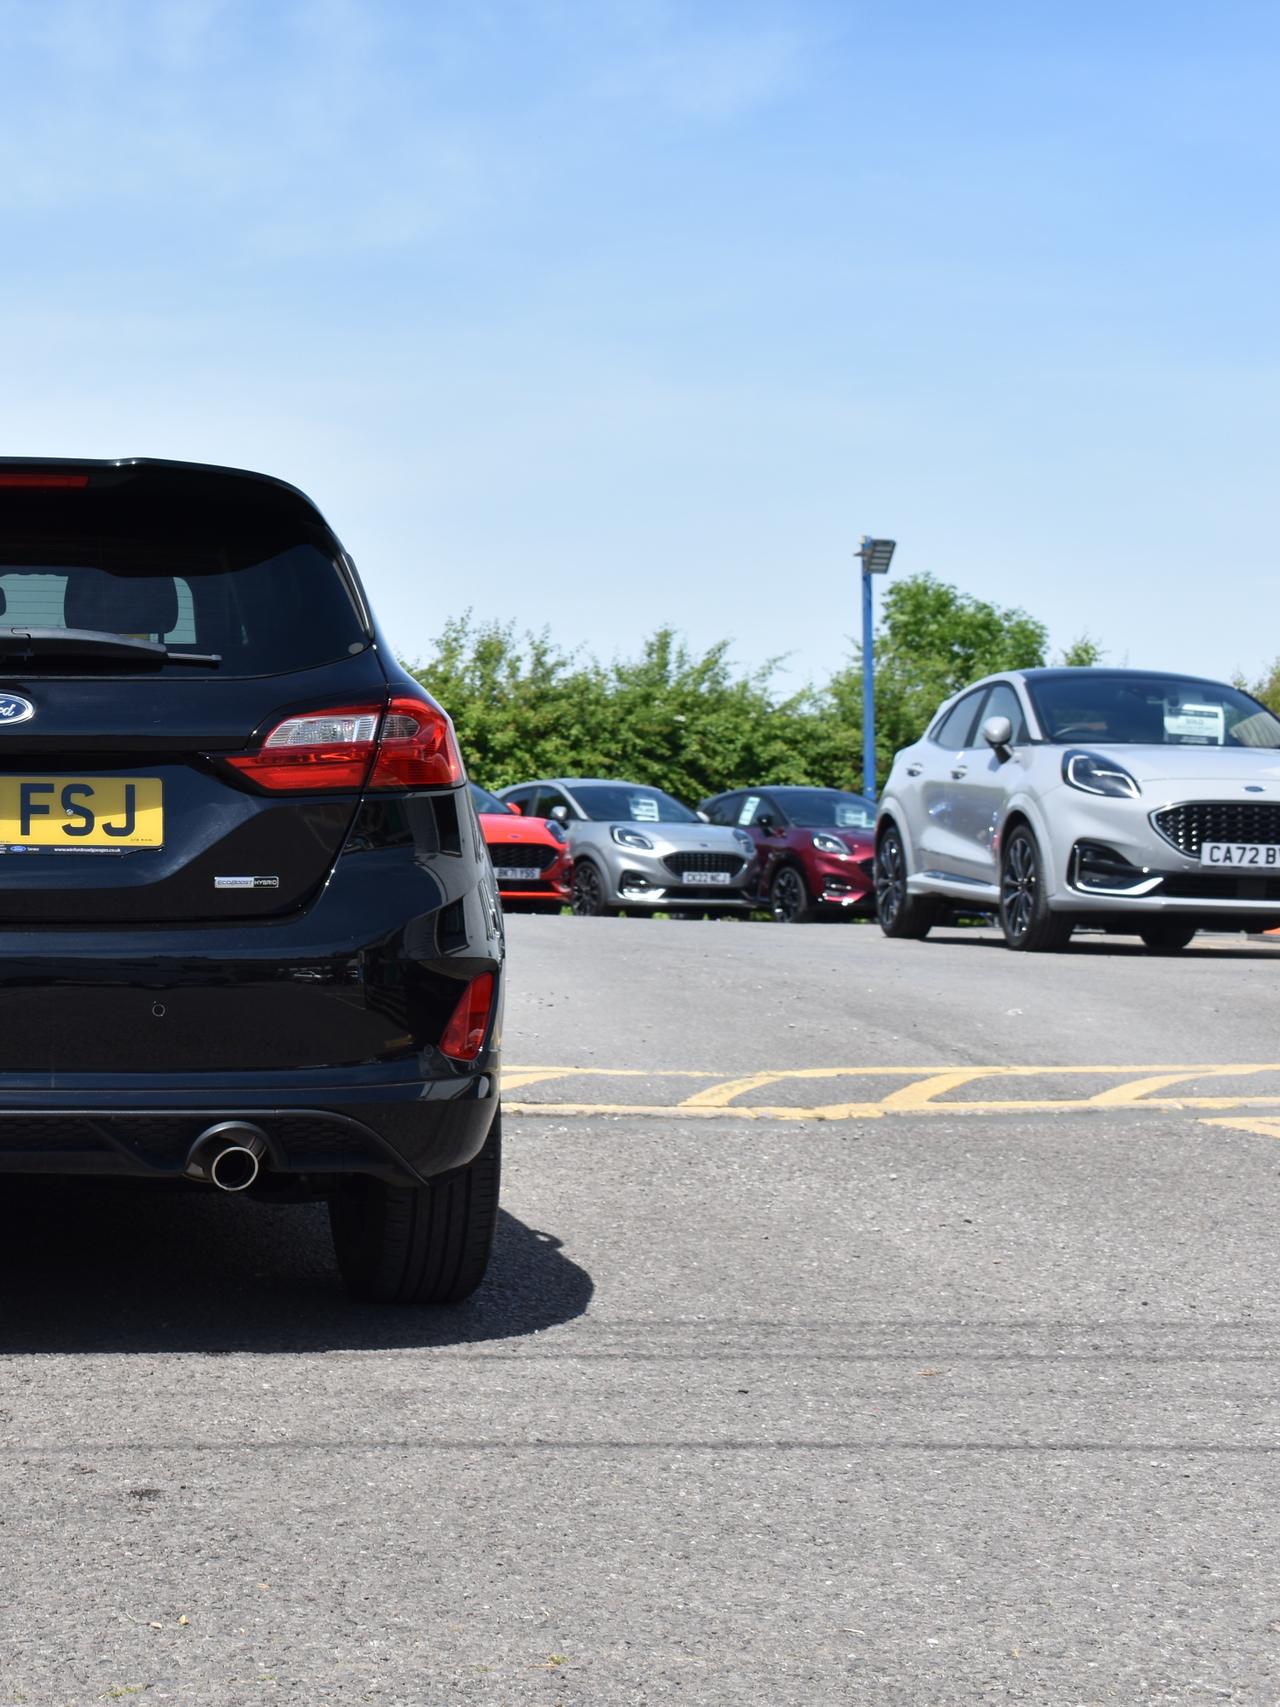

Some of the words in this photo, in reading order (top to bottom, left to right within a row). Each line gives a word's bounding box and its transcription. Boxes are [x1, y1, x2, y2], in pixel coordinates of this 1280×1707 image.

[20, 783, 136, 838] FSJ
[1209, 845, 1259, 864] CA72
[1265, 847, 1280, 865] B
